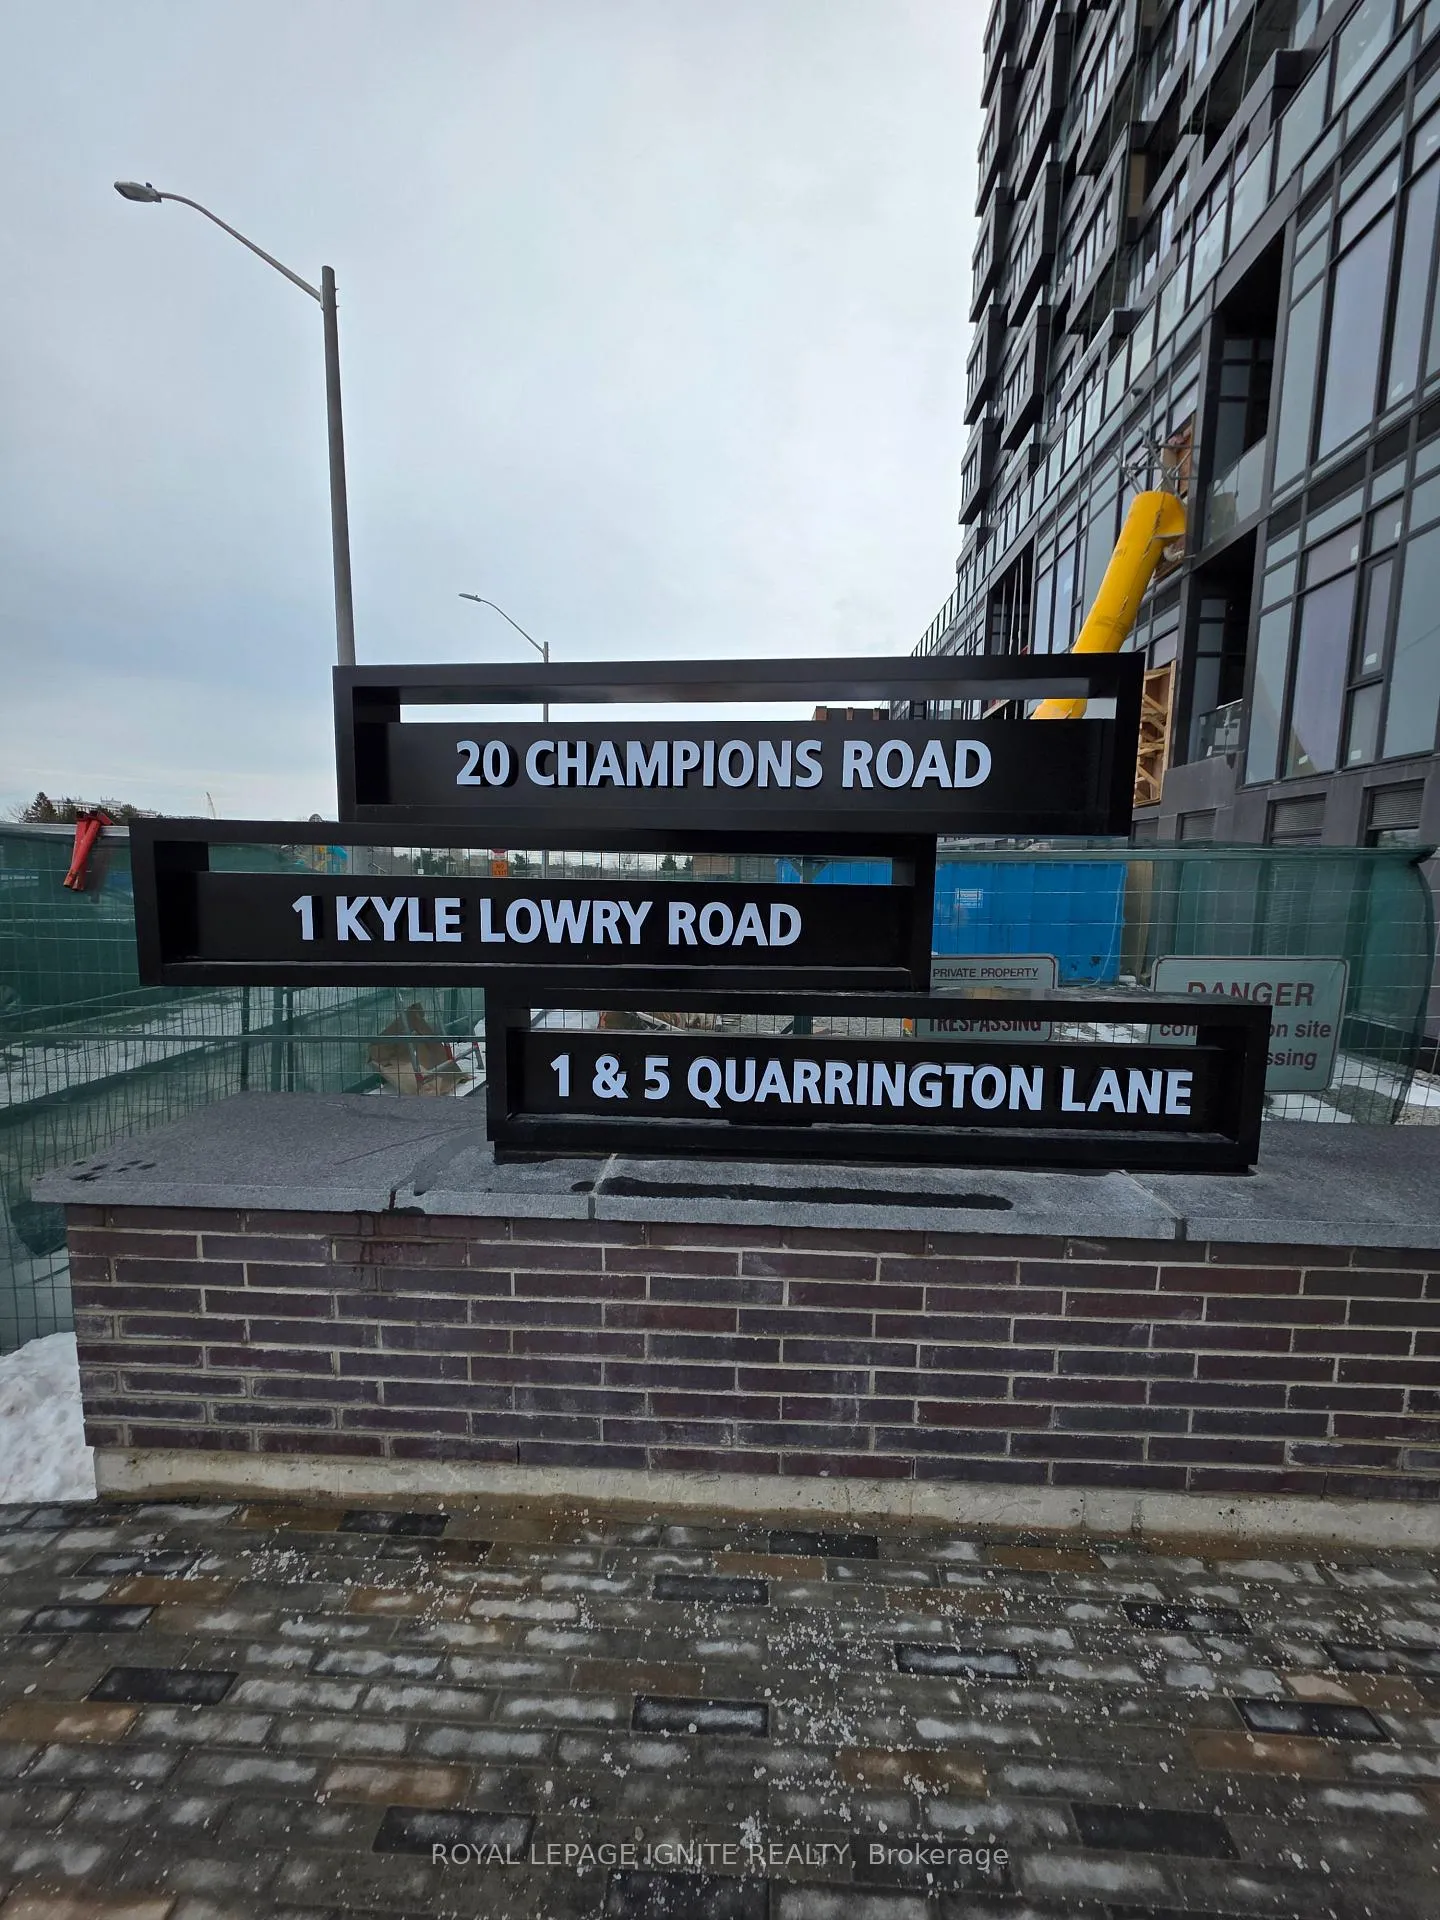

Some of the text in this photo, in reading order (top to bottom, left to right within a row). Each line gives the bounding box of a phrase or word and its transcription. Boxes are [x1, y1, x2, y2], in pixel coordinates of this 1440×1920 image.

[455, 739, 992, 788] 20 CHAMPIONS ROAD
[292, 895, 802, 947] 1 KYLE LOWRY ROAD
[932, 967, 1039, 978] PRIVATE PROPERTY
[1294, 1020, 1332, 1038] site
[550, 1054, 1193, 1115] 1 & 5 QUARRINGTON LANE
